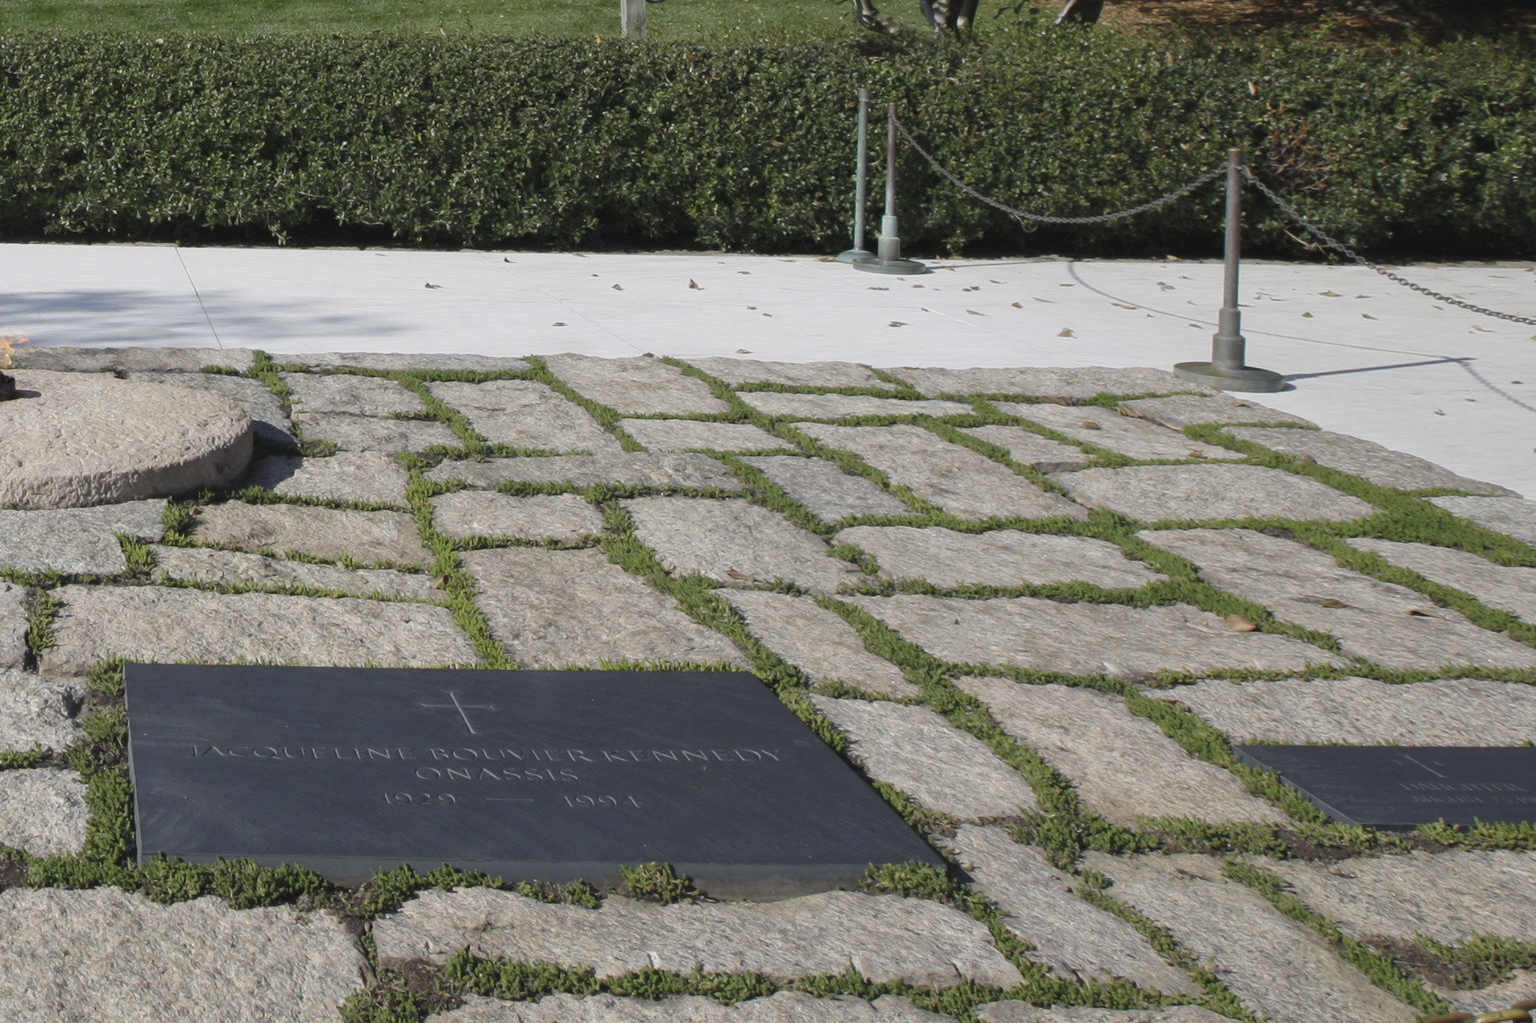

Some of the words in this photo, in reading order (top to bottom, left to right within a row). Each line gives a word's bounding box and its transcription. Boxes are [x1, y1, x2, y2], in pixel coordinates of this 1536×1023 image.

[188, 745, 414, 761] JACQUELINE
[428, 746, 593, 763] BOUVIER
[599, 748, 782, 763] KENNEDY
[414, 766, 579, 782] ONASSIS
[383, 791, 457, 806] 1929
[562, 794, 643, 809] 1994
